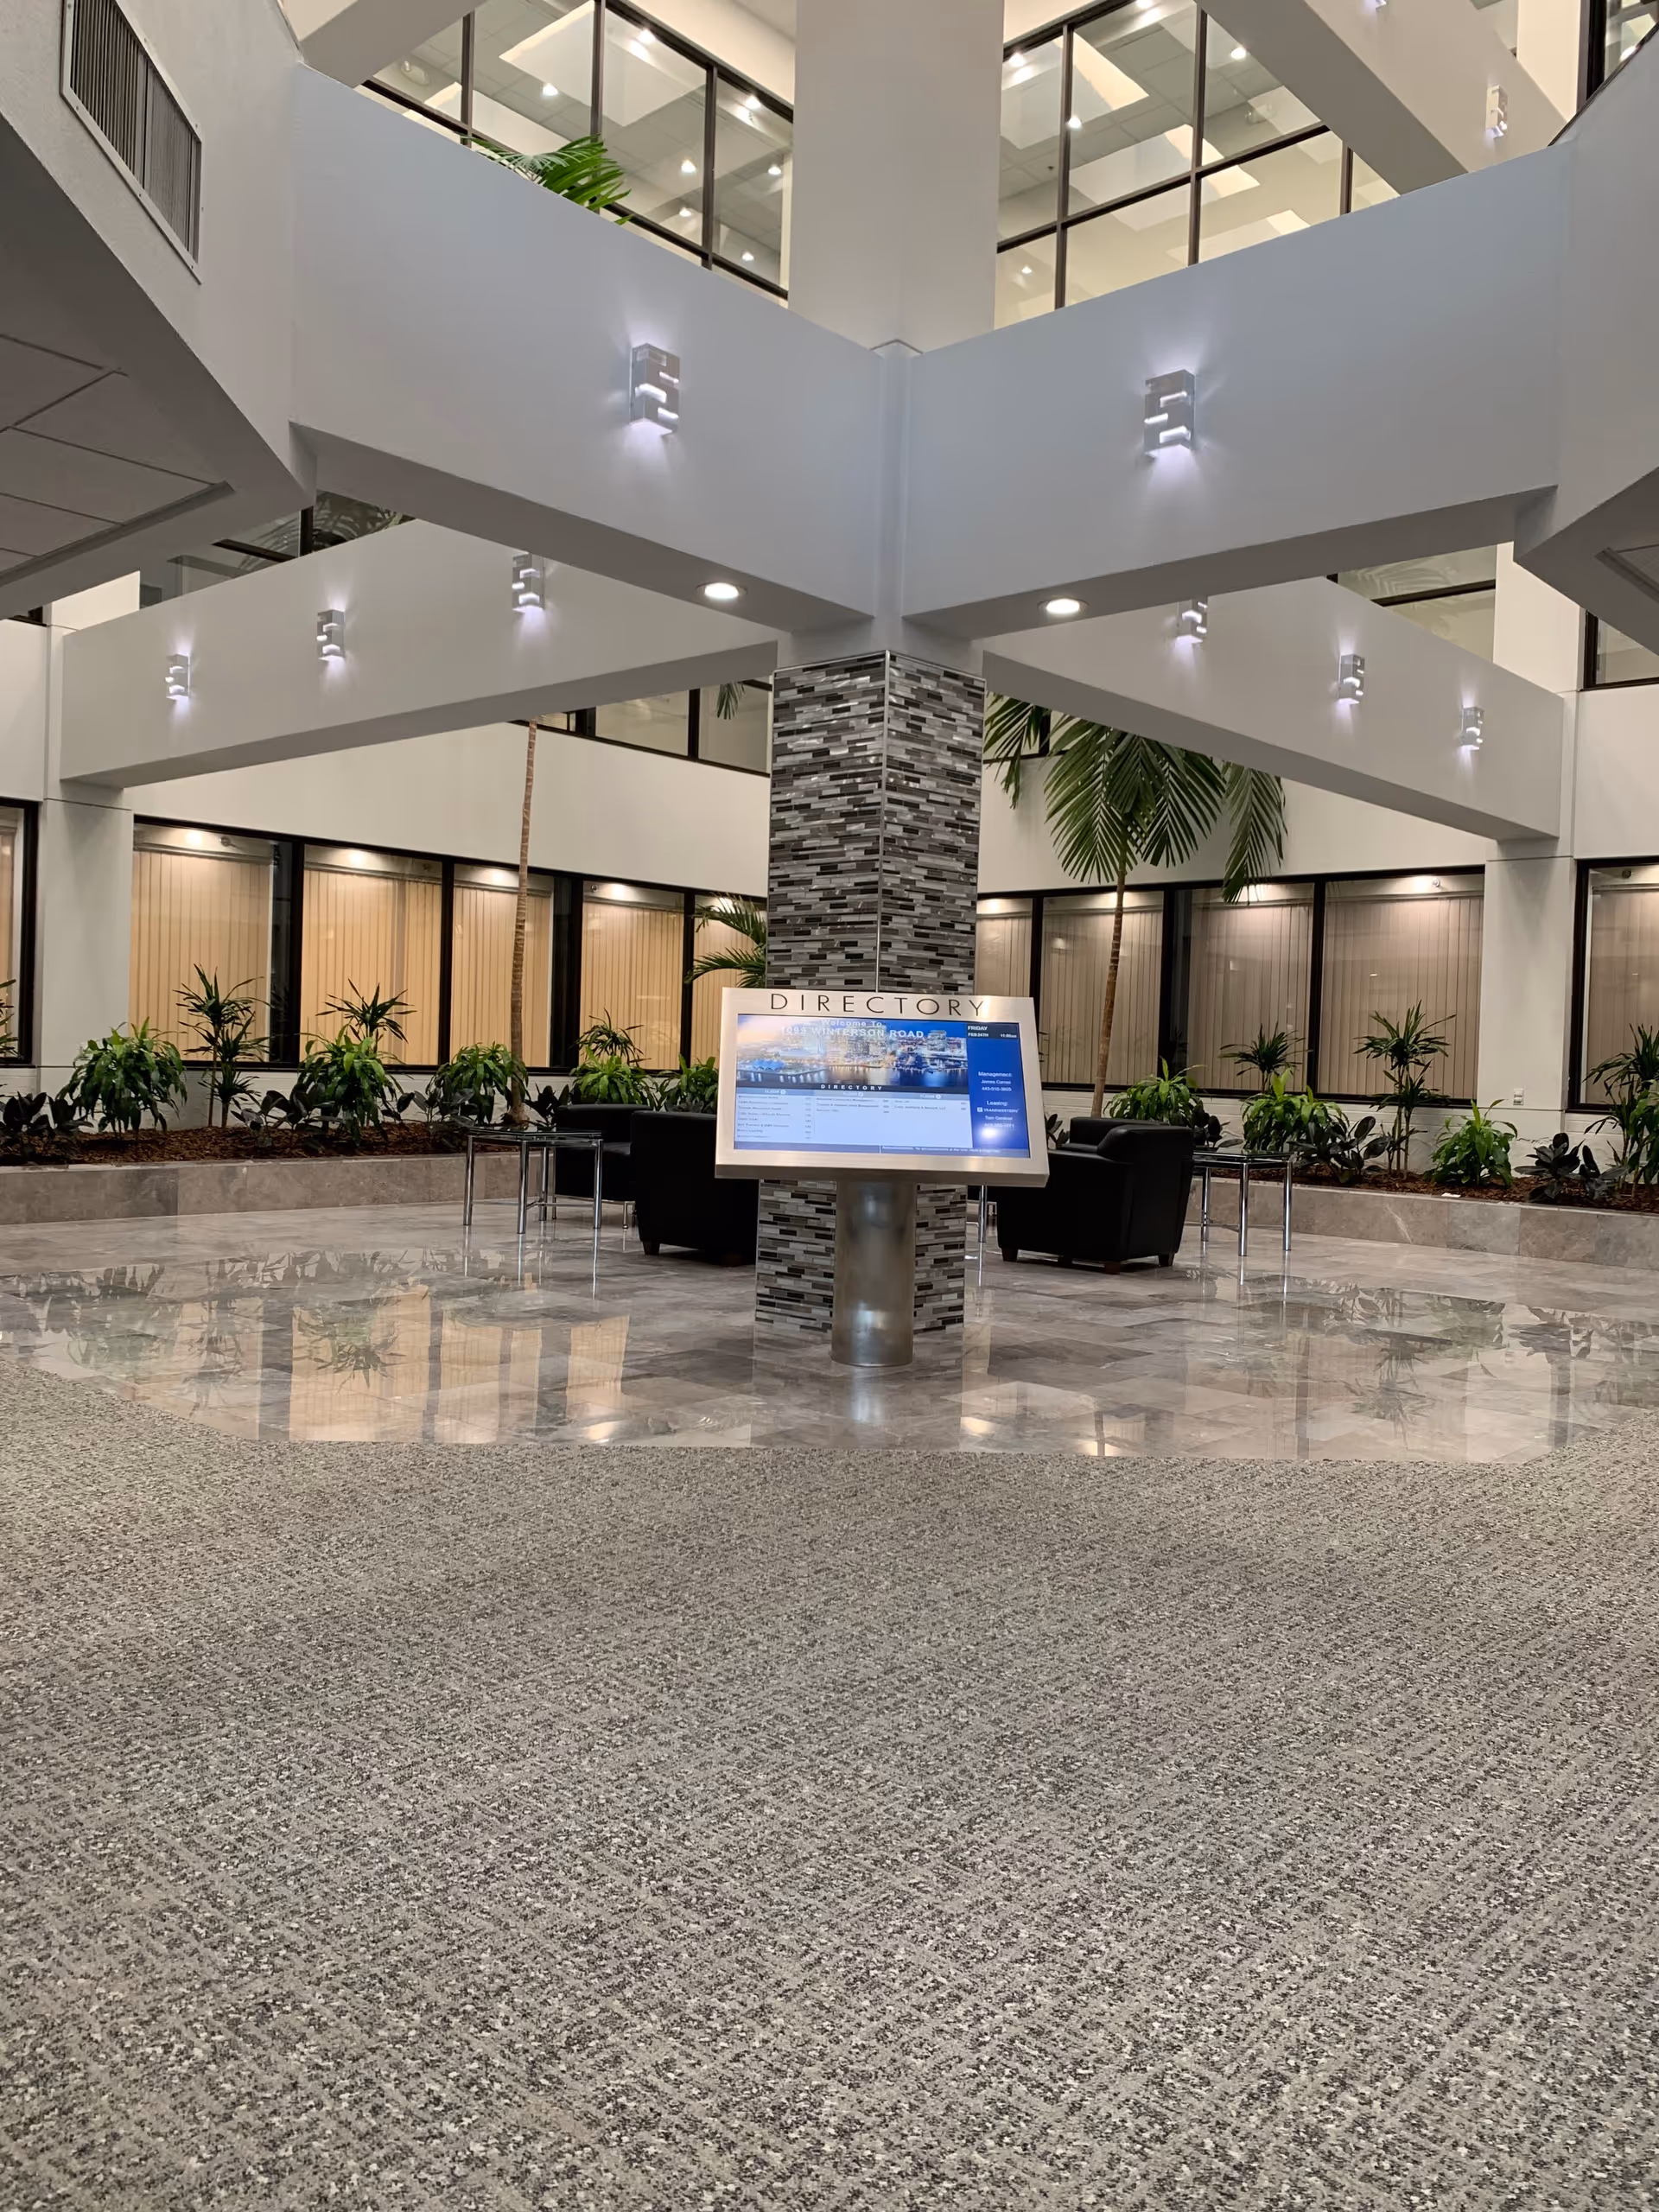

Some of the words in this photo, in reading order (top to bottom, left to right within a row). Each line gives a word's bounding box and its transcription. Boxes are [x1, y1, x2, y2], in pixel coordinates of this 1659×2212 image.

[770, 993, 985, 1017] DIRECTORY
[821, 1019, 867, 1027] Welcome
[811, 1027, 885, 1037] WINTERSON
[889, 1029, 925, 1039] ROAD
